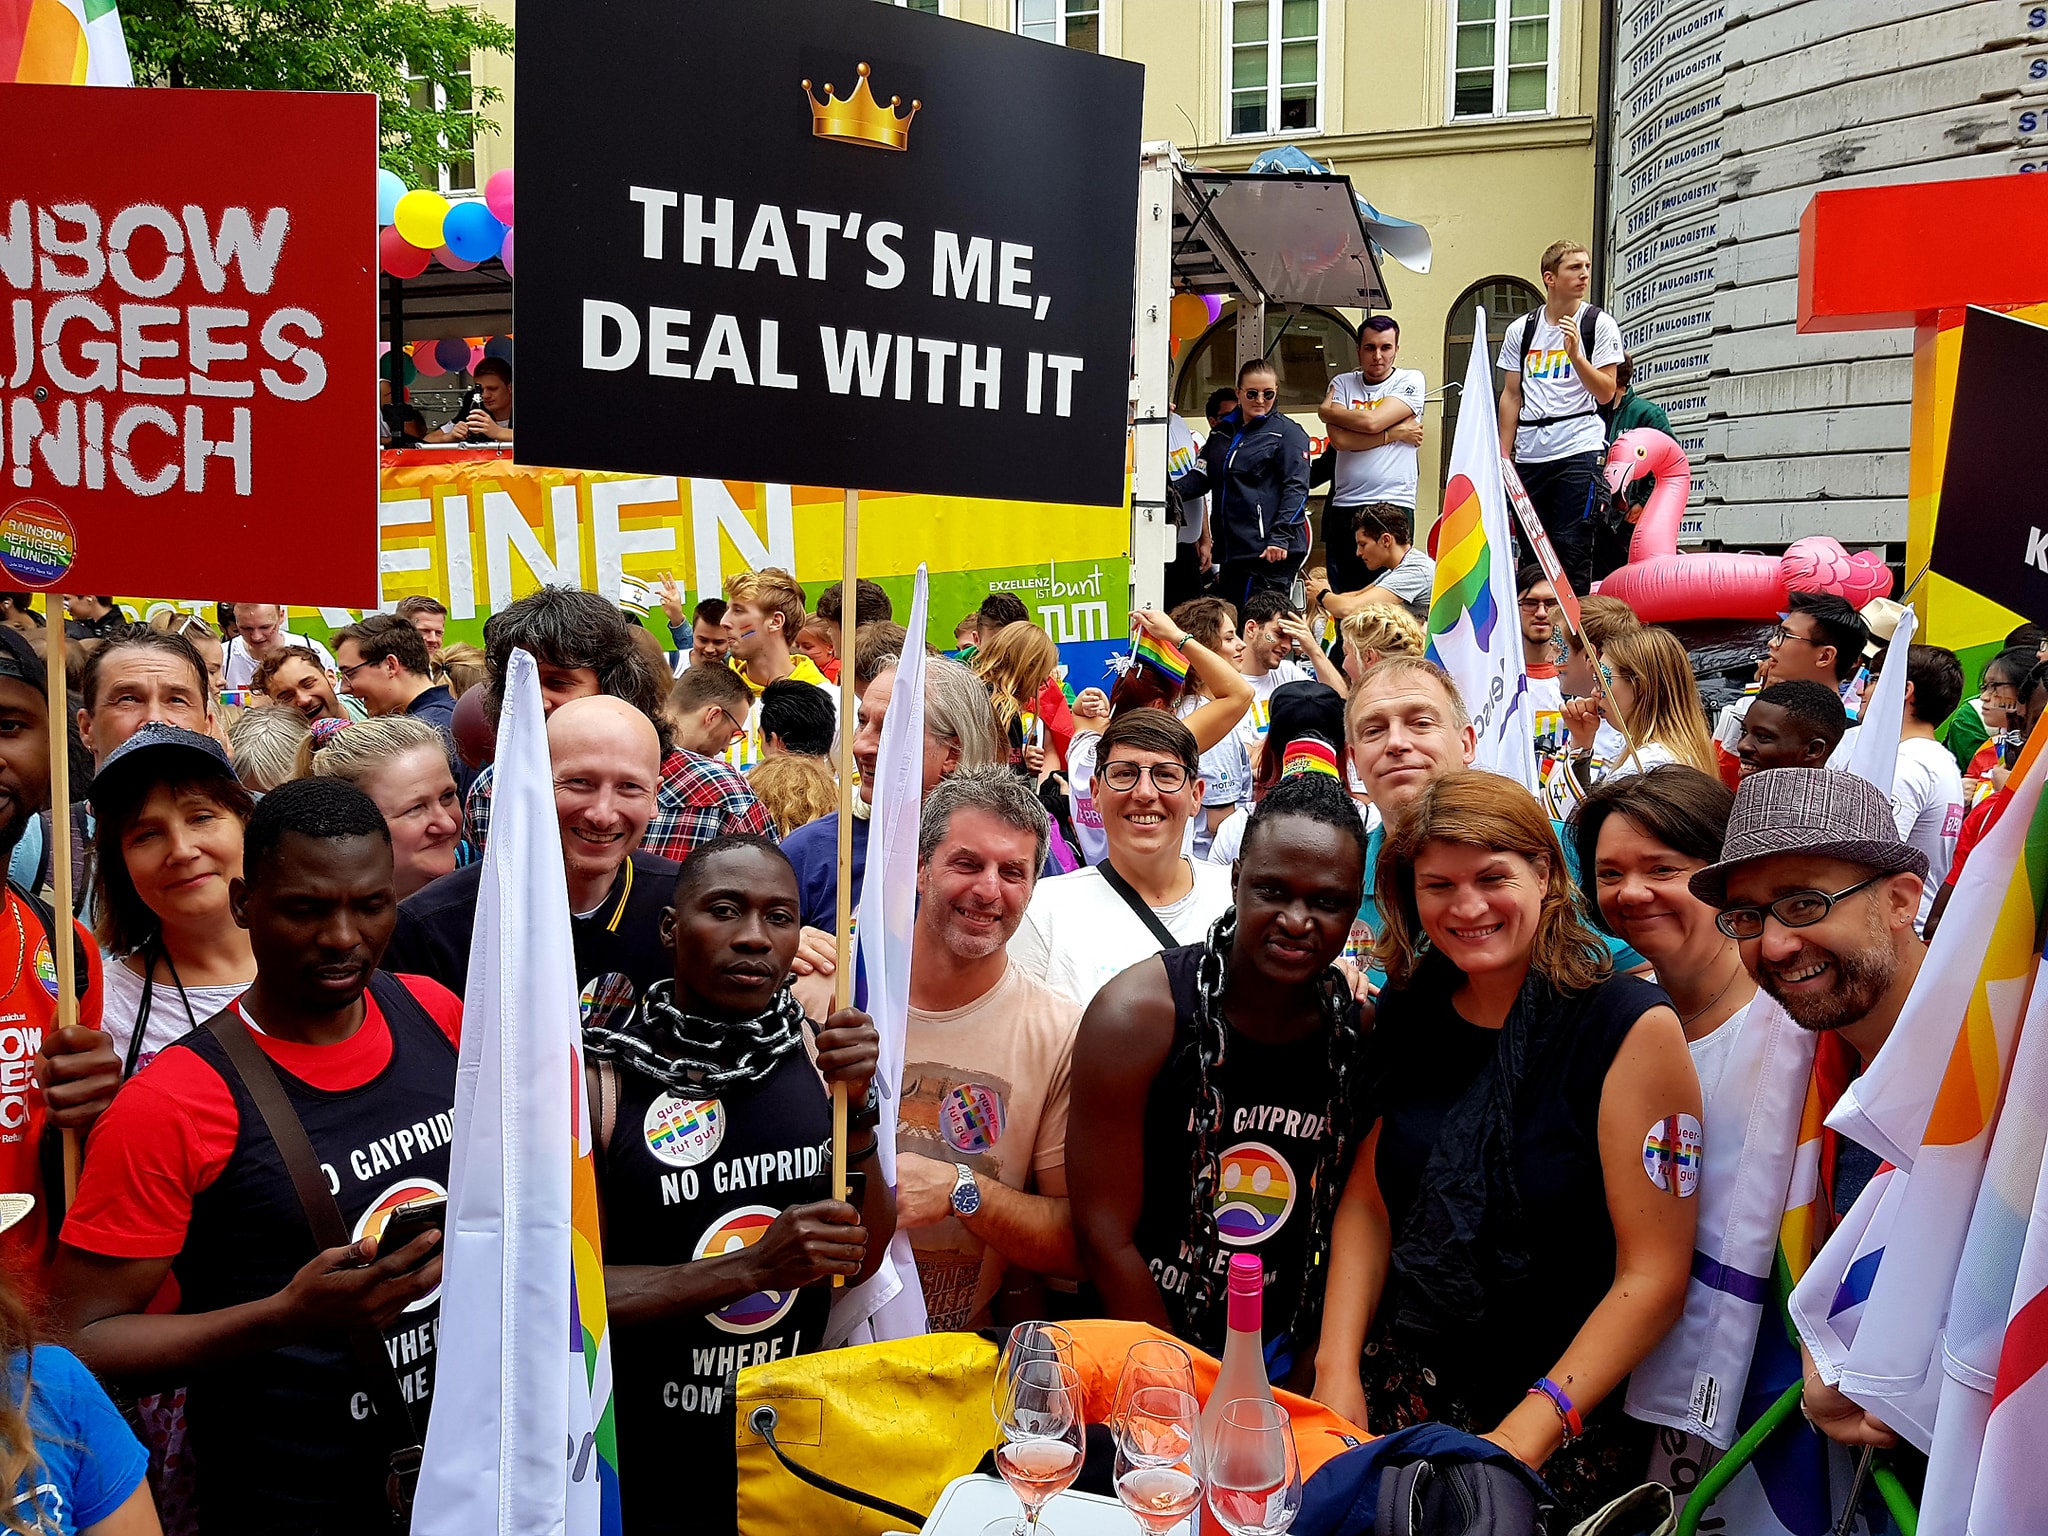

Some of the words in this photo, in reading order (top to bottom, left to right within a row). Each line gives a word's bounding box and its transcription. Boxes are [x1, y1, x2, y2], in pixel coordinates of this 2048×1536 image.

[1667, 6, 1725, 45] BAULOGISTIK
[1665, 51, 1723, 87] BAULOGISTIK
[1665, 94, 1722, 129] BAULOGISTIK
[1664, 136, 1721, 170] BAULOGISTIK
[1661, 181, 1718, 211] BAULOGISTIK
[630, 185, 906, 291] THAT'S
[932, 229, 1052, 321] ME,
[1660, 223, 1717, 252] BAULOGISTIK
[1658, 267, 1714, 293] BAULOGISTIK
[1656, 310, 1712, 334] BAULOGISTIK
[583, 298, 798, 390] DEAL
[820, 325, 1001, 411] WITH
[1026, 351, 1084, 418] IT
[1654, 353, 1710, 374] BAULOGISTIK
[0, 396, 252, 497] NICH
[3, 531, 68, 557] REFUGEES
[8, 519, 66, 542] RAINBOW
[10, 545, 58, 567] MUNICH
[989, 577, 1050, 592] EXZELLENZ
[1035, 588, 1051, 599] IST
[1050, 557, 1104, 598] bunt
[646, 1099, 719, 1151] MUT
[671, 1139, 691, 1156] tut
[694, 1125, 716, 1147] gut
[947, 1105, 961, 1123] tut
[954, 1125, 971, 1145] gut
[660, 1168, 700, 1206] NO
[663, 1380, 724, 1416] COM
